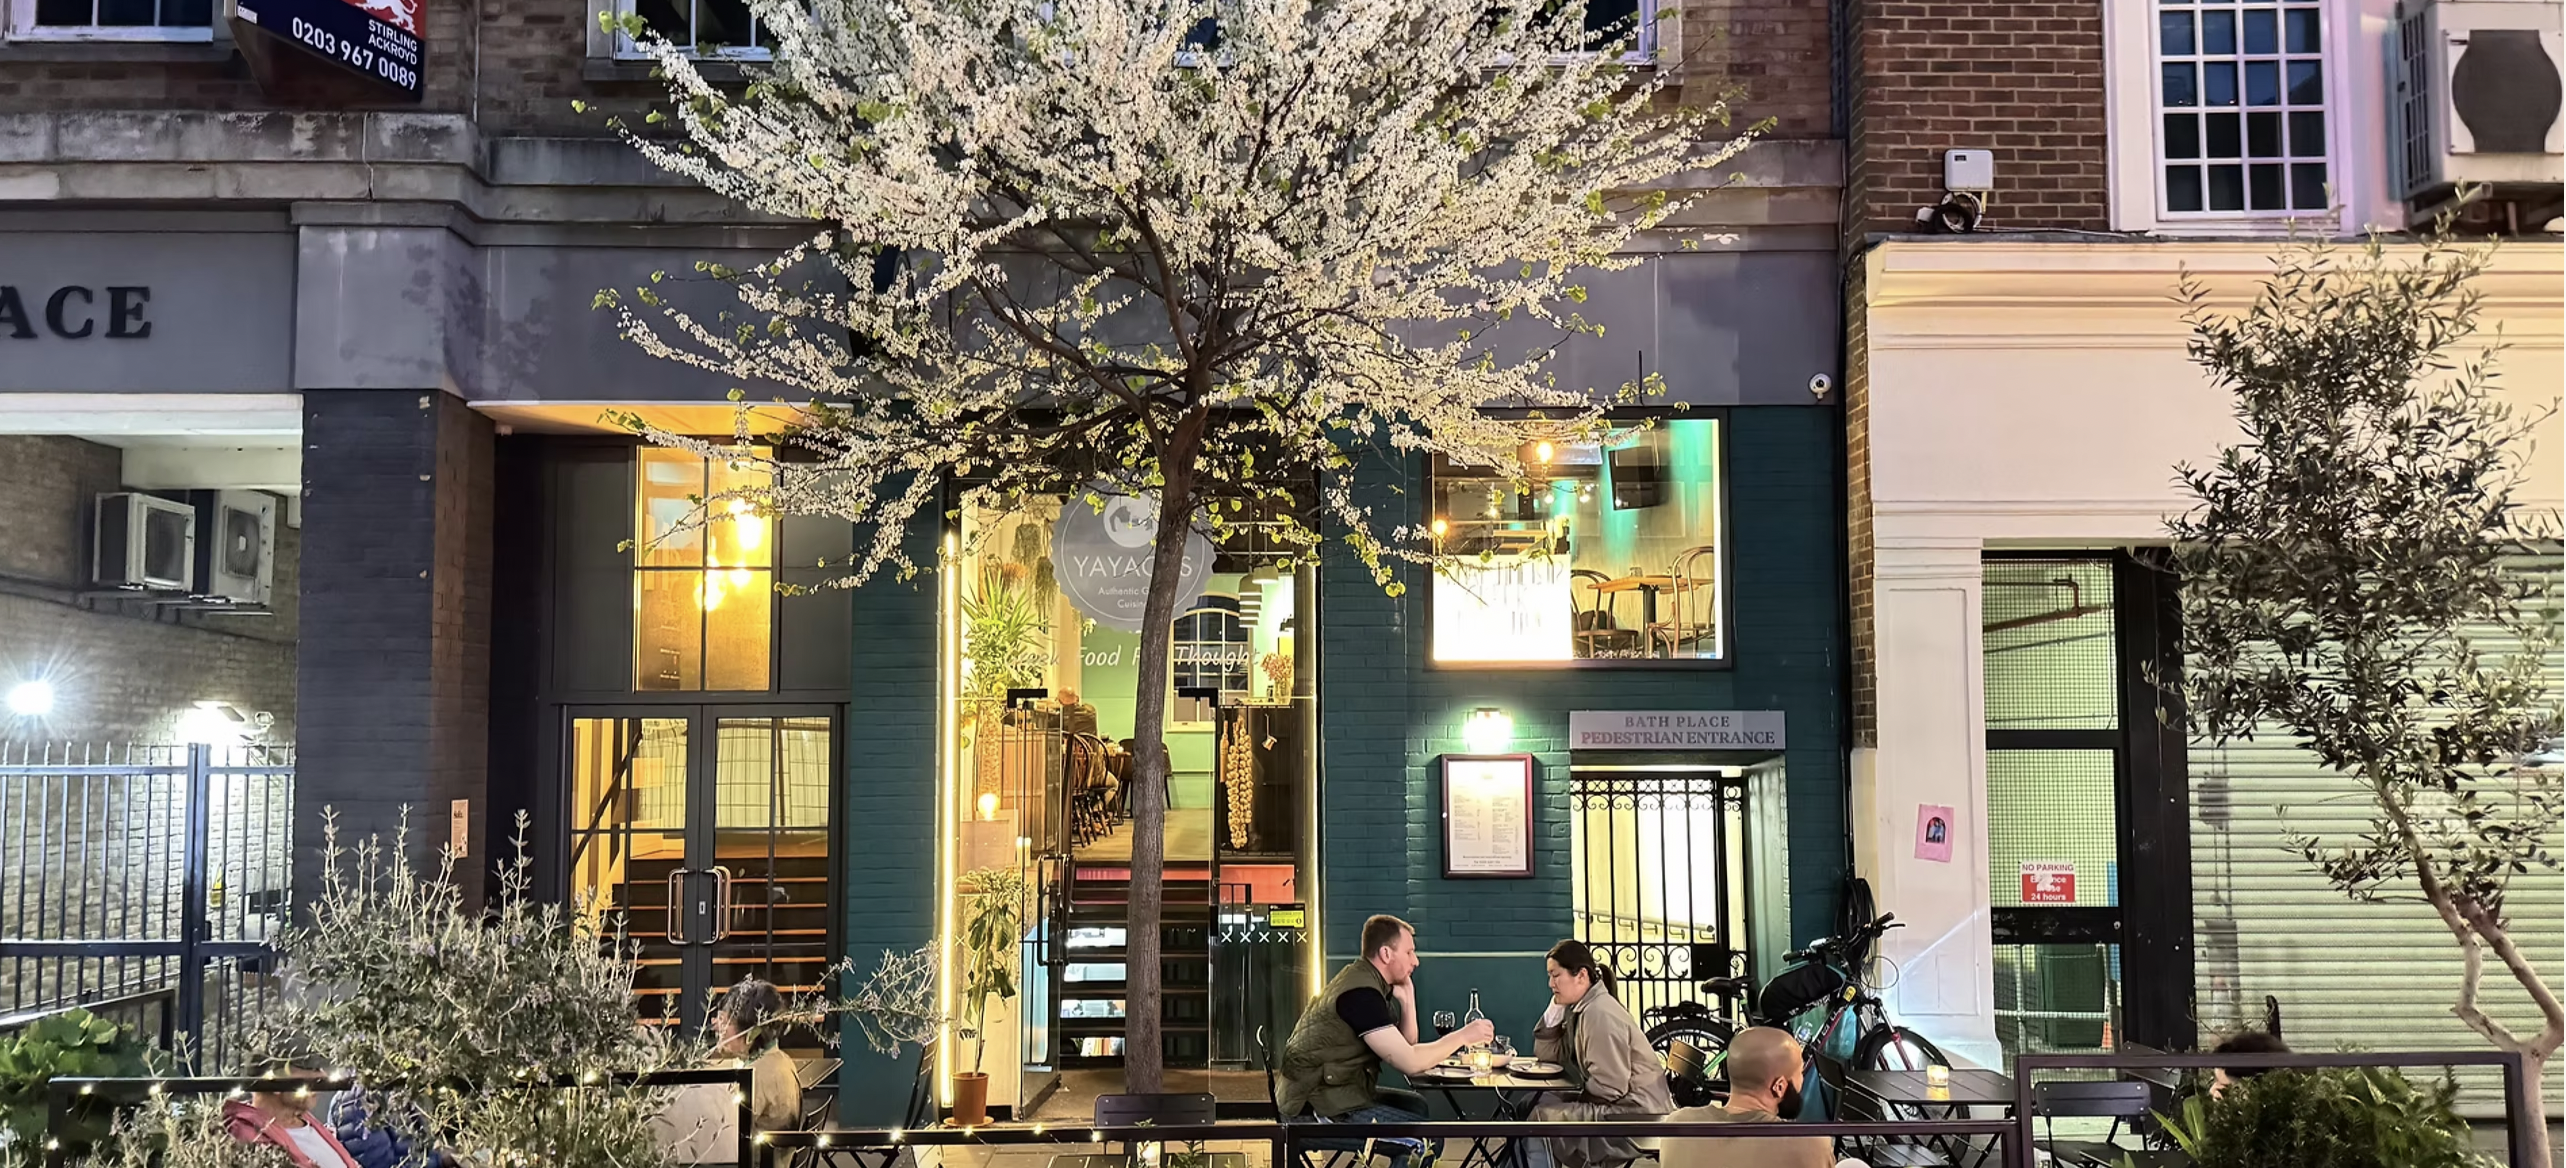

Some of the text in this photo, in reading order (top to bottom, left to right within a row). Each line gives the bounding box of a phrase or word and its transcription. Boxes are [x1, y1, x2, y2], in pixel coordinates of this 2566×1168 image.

[368, 19, 417, 53] STIRLING
[292, 17, 417, 91] 0203 967 0089
[368, 33, 417, 65] ACKROYD
[1625, 716, 1730, 728] BATH PLACE
[1580, 731, 1775, 745] PEDESTRIAN ENTRANCE
[2036, 864, 2074, 872] PARKING
[2031, 892, 2066, 901] 24 hours
